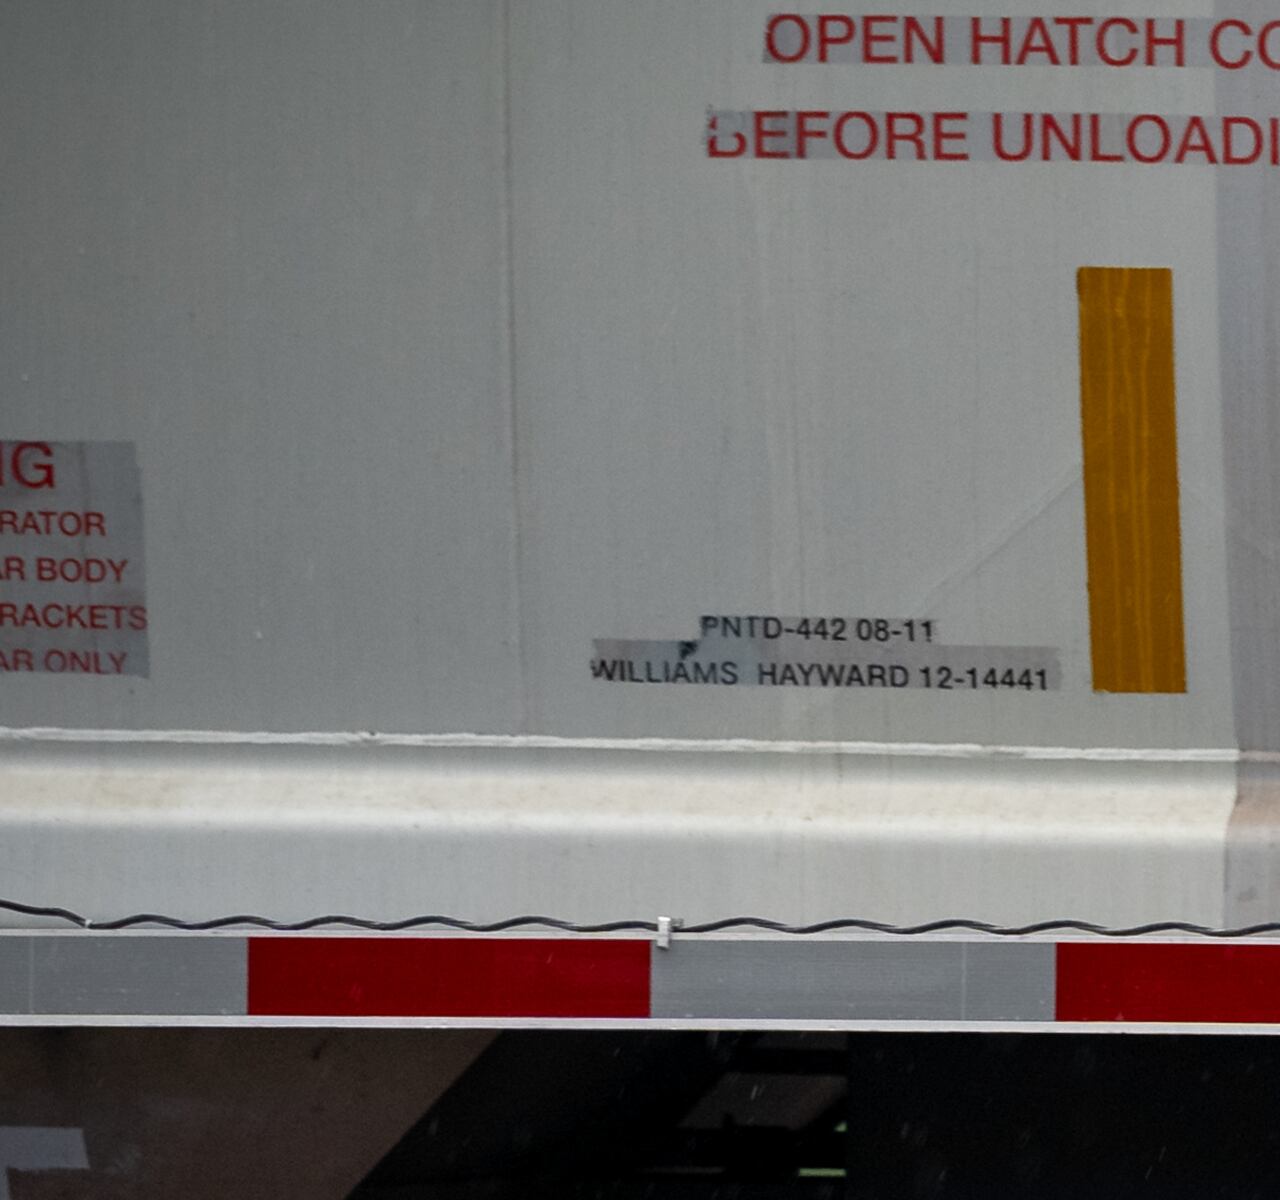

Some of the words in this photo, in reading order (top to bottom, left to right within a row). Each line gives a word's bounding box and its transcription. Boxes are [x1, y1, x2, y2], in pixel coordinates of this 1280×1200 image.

[765, 13, 945, 64] OPEN
[970, 17, 1185, 67] HATCH
[0, 441, 55, 489] G
[37, 558, 128, 582] BODY
[700, 615, 847, 641] PNTD-442
[857, 619, 933, 642] 08-11
[45, 650, 127, 674] ONLY
[591, 658, 738, 684] WILLIAMS
[757, 663, 909, 687] HAYWARD
[920, 666, 1048, 690] 12-14441
